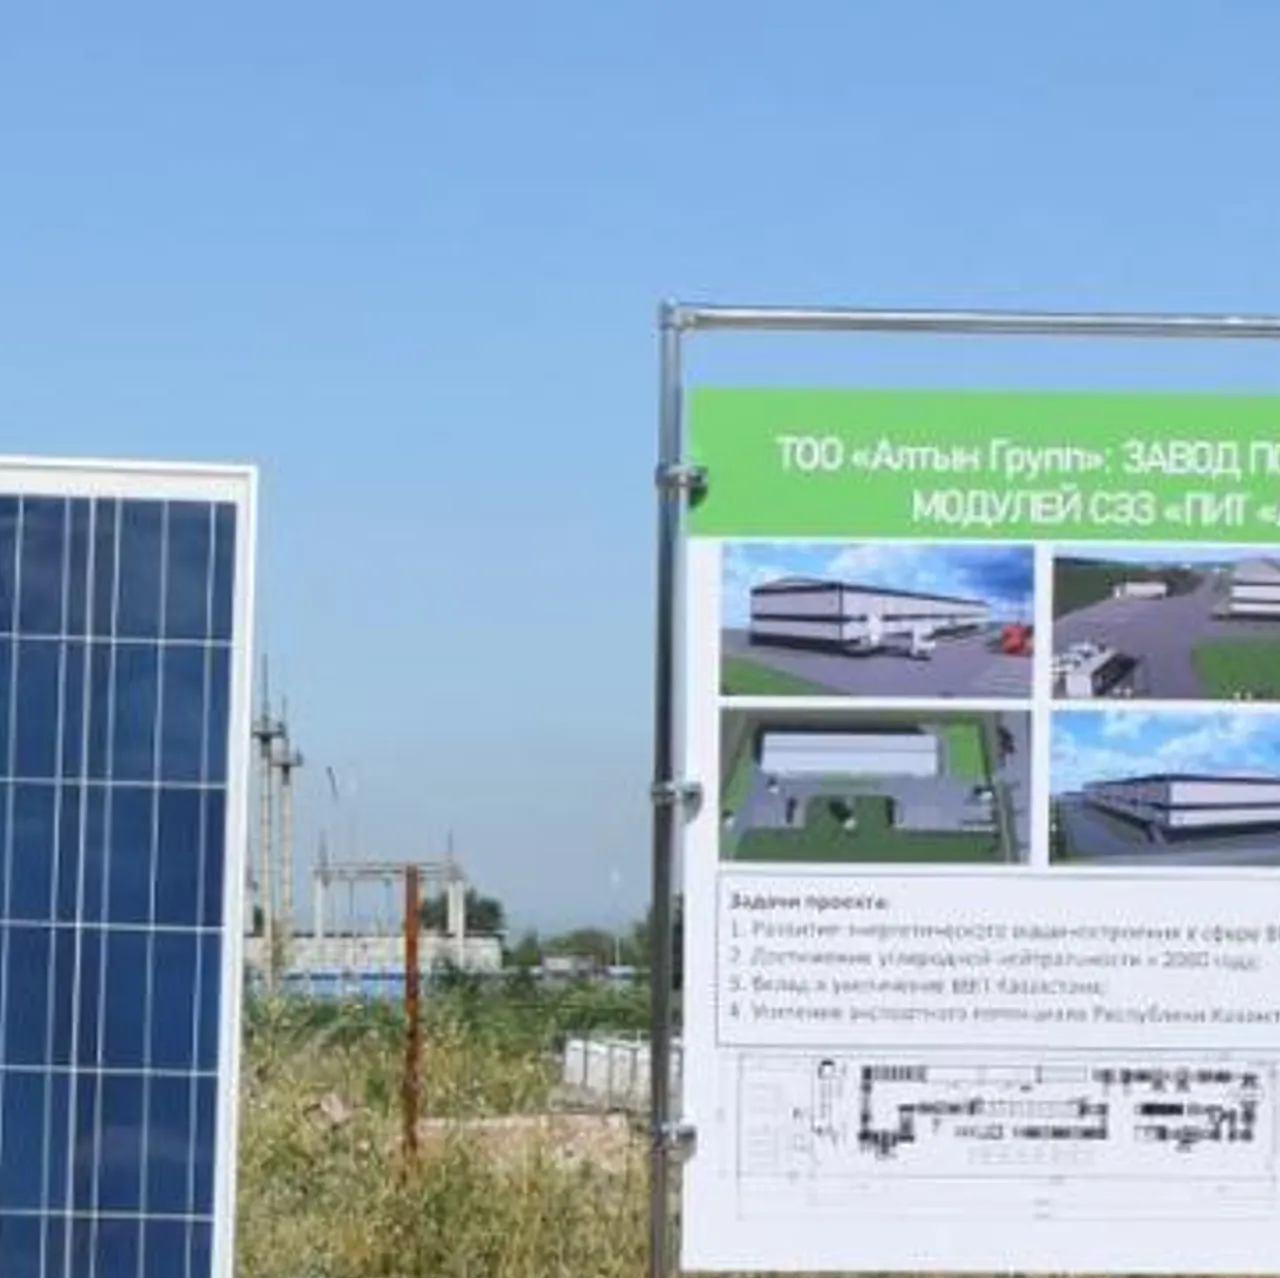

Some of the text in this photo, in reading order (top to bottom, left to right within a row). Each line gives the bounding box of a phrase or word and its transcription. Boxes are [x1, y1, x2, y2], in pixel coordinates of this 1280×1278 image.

[776, 436, 843, 471] ТОО
[851, 438, 981, 474] «Алтын
[989, 440, 1113, 482] Групп»:
[1123, 442, 1240, 481] ЗАВОД
[912, 484, 1081, 529] МОДУЛЕЙ
[1164, 494, 1248, 528] «ПИТ
